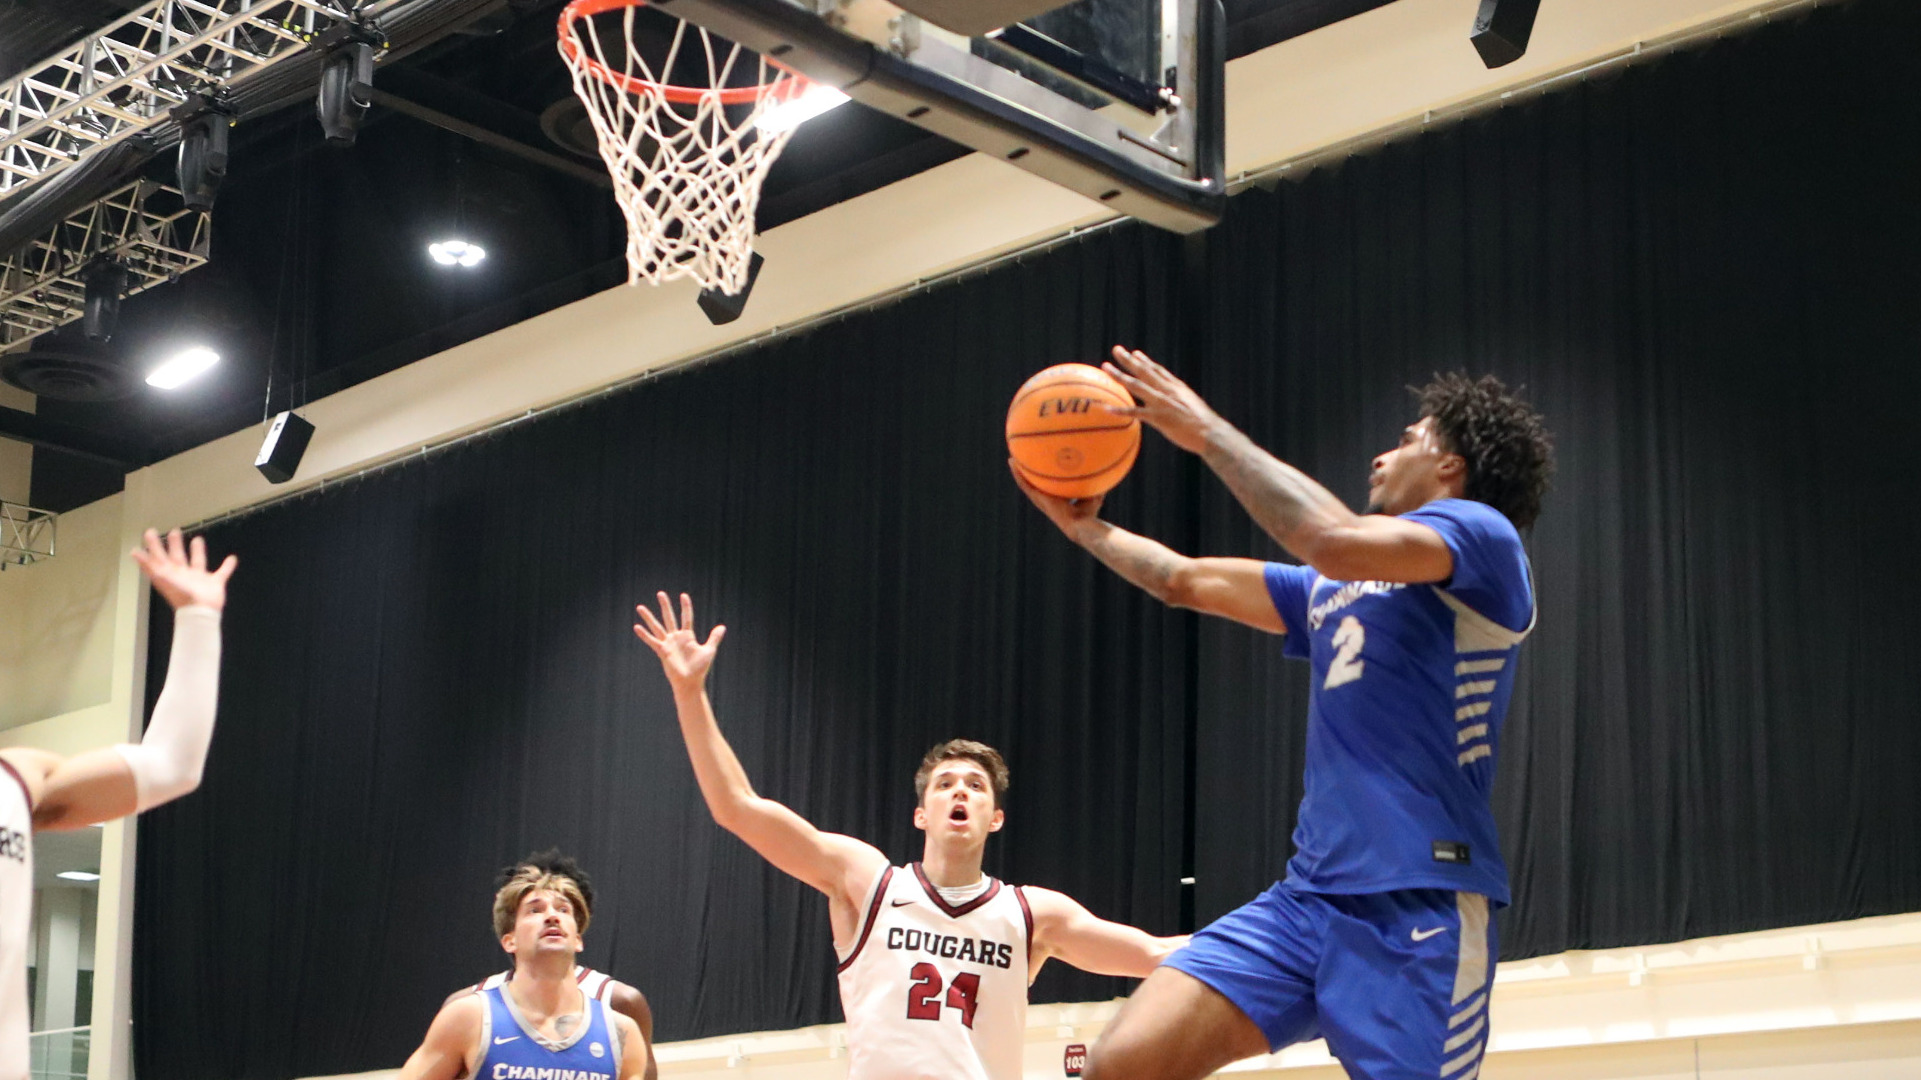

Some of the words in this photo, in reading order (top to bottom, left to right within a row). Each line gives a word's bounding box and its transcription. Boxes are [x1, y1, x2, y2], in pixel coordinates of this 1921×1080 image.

[1323, 614, 1365, 691] 2
[887, 927, 1013, 970] COUGARS
[906, 961, 981, 1030] 24
[1065, 1055, 1086, 1070] 103
